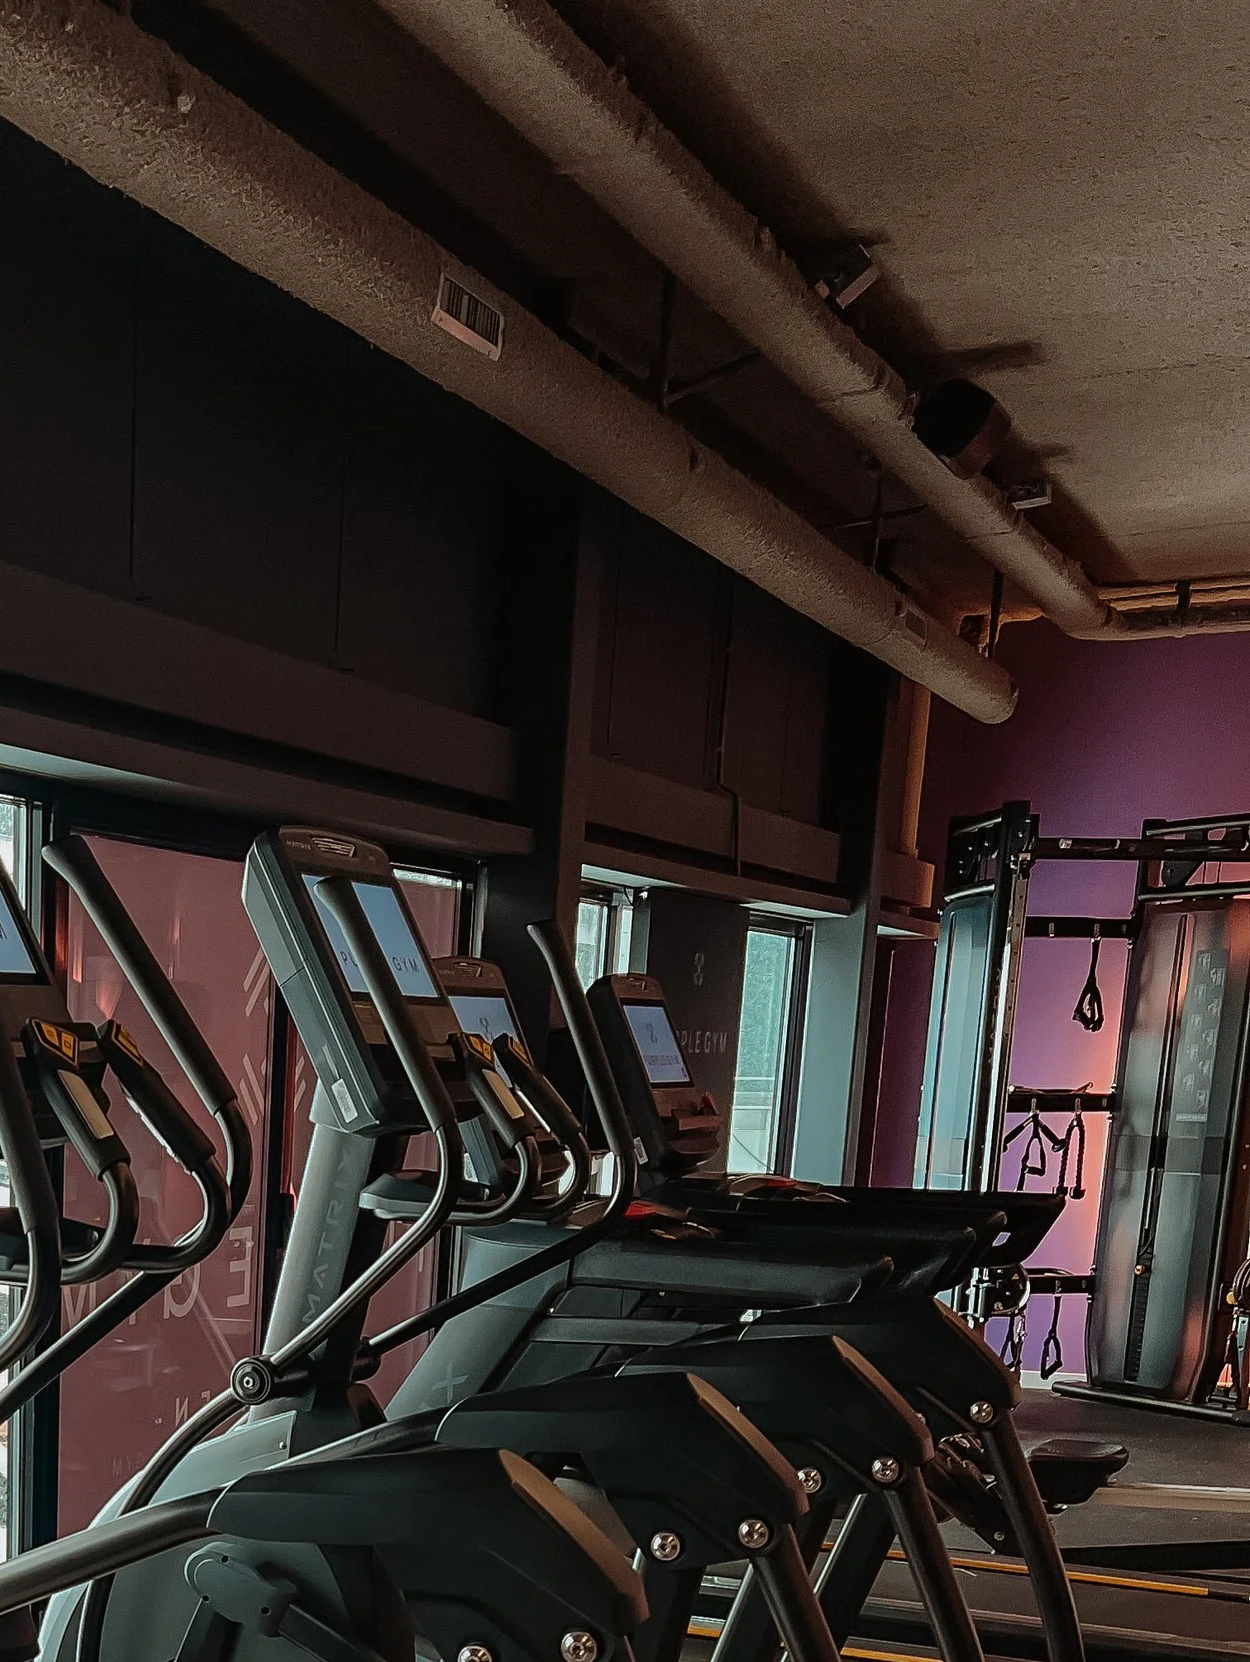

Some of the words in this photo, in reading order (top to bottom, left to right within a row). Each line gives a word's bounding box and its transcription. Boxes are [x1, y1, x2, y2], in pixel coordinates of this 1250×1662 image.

[391, 956, 421, 973] GYM
[678, 1030, 701, 1054] PLE
[703, 1031, 728, 1054] GYM
[301, 1144, 359, 1325] MATRIX
